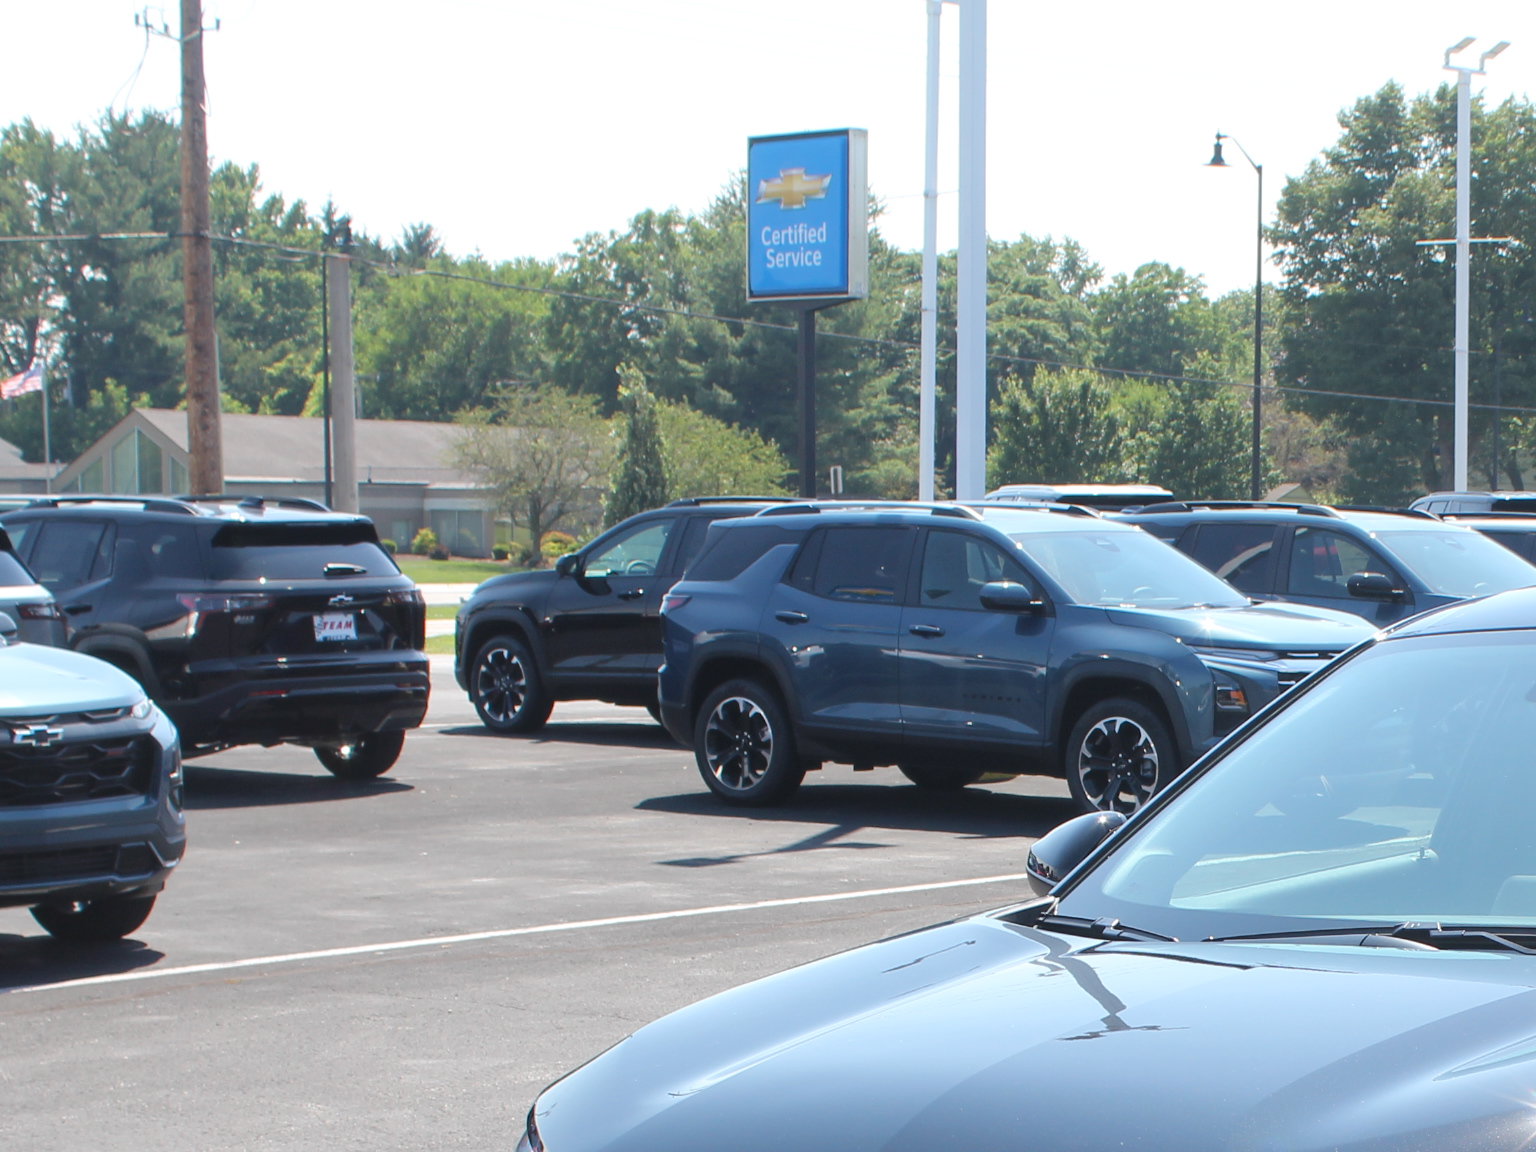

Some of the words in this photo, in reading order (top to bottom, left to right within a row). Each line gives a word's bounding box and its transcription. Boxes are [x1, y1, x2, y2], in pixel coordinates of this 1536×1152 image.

[761, 221, 826, 246] Certified
[766, 246, 822, 268] Service
[323, 620, 353, 631] TEAM
